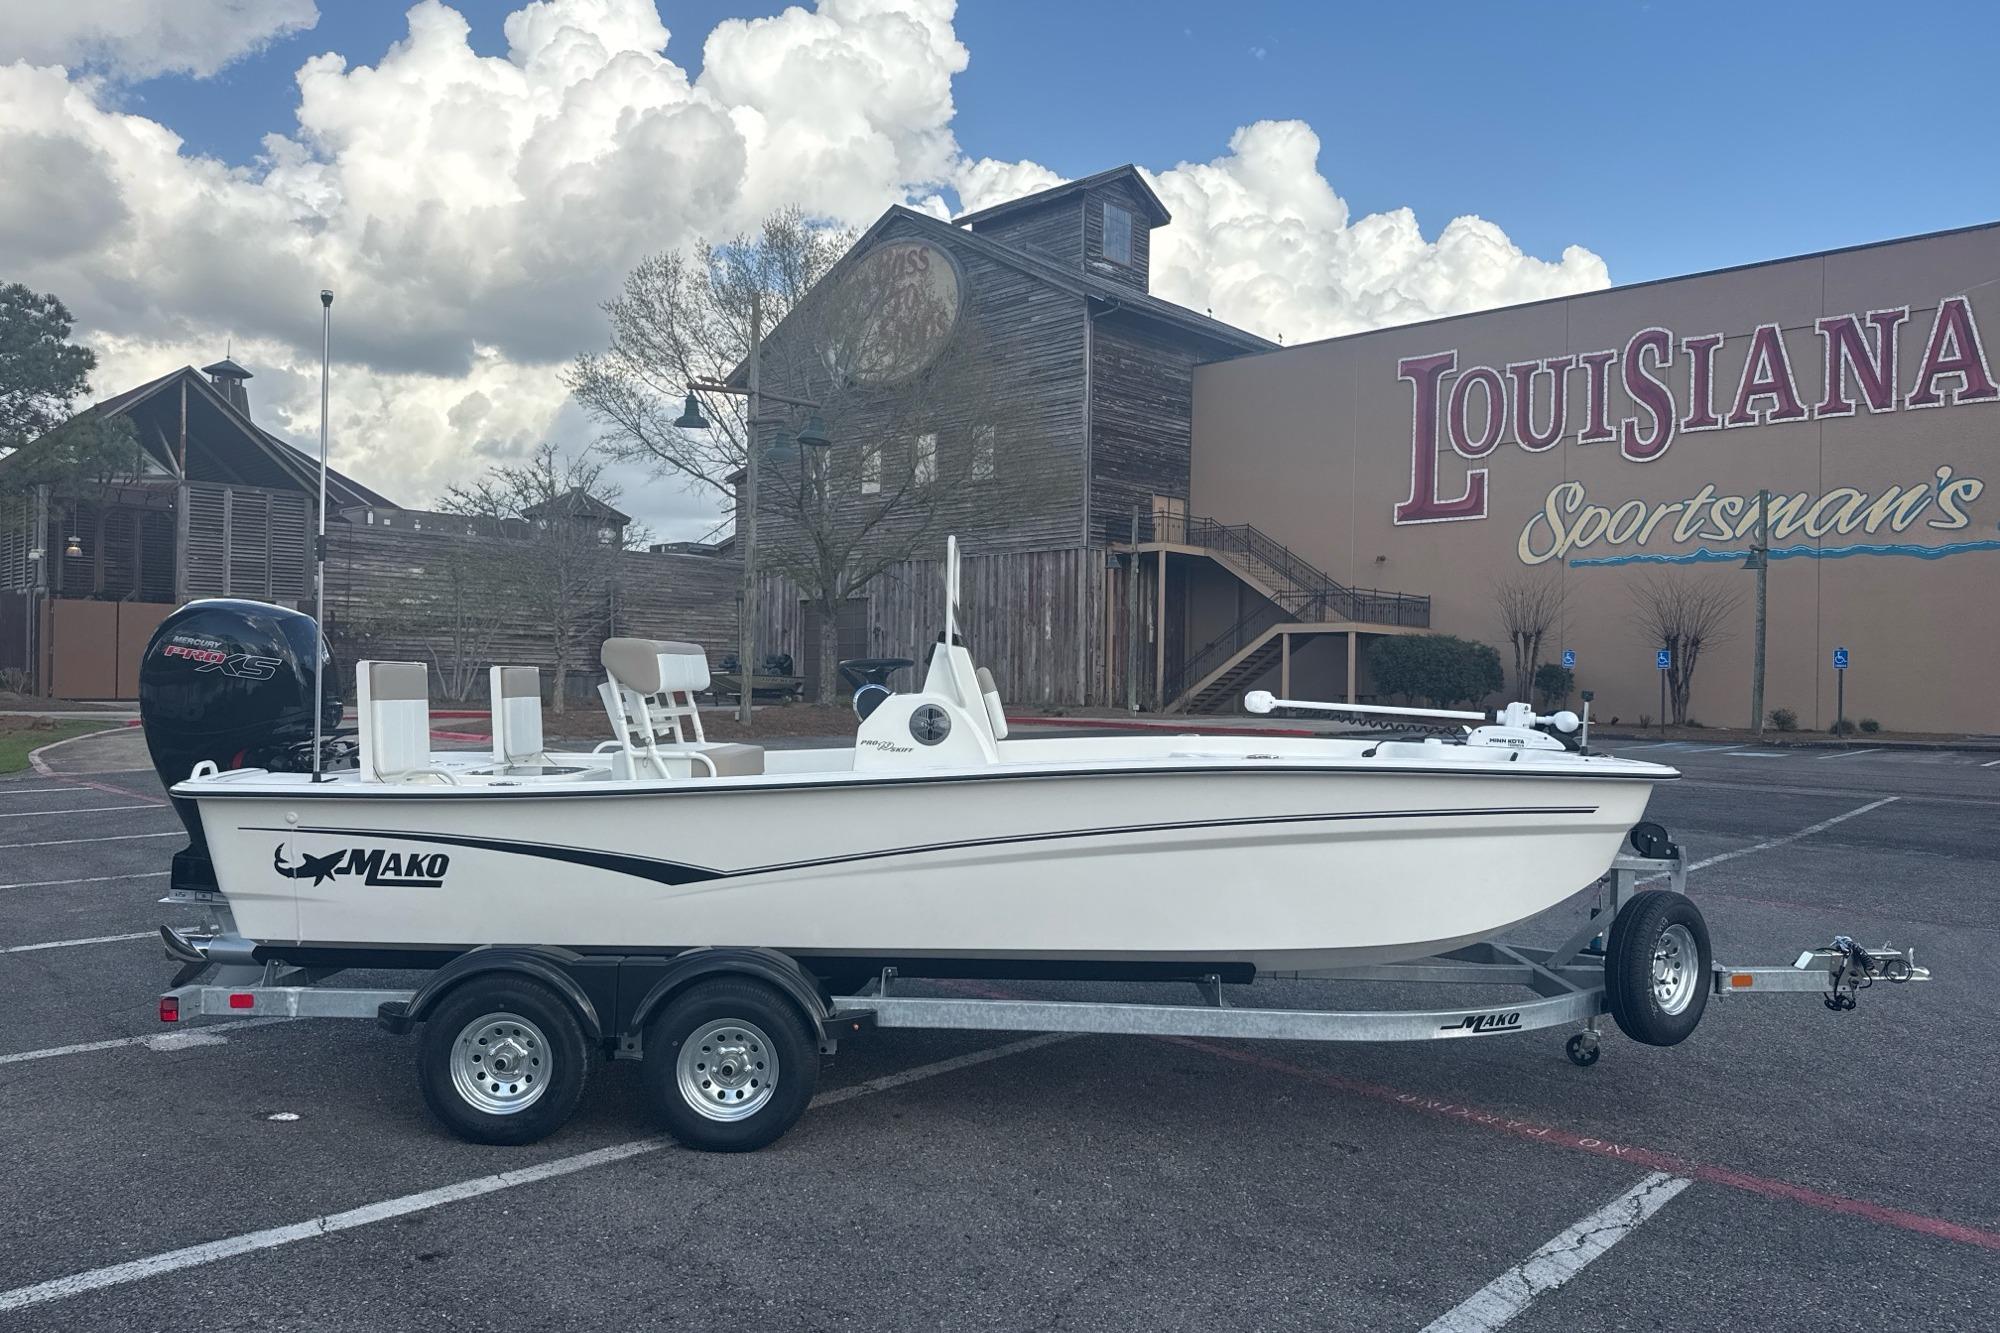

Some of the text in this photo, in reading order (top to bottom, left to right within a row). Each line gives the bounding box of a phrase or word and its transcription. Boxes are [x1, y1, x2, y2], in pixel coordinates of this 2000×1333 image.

[1393, 296, 2000, 525] LOUISIANA
[1517, 465, 1985, 566] Sportsman's
[172, 635, 222, 648] MERCURY
[163, 645, 283, 681] PRO XS
[333, 848, 450, 888] MAKO
[1440, 1012, 1523, 1034] MAKO
